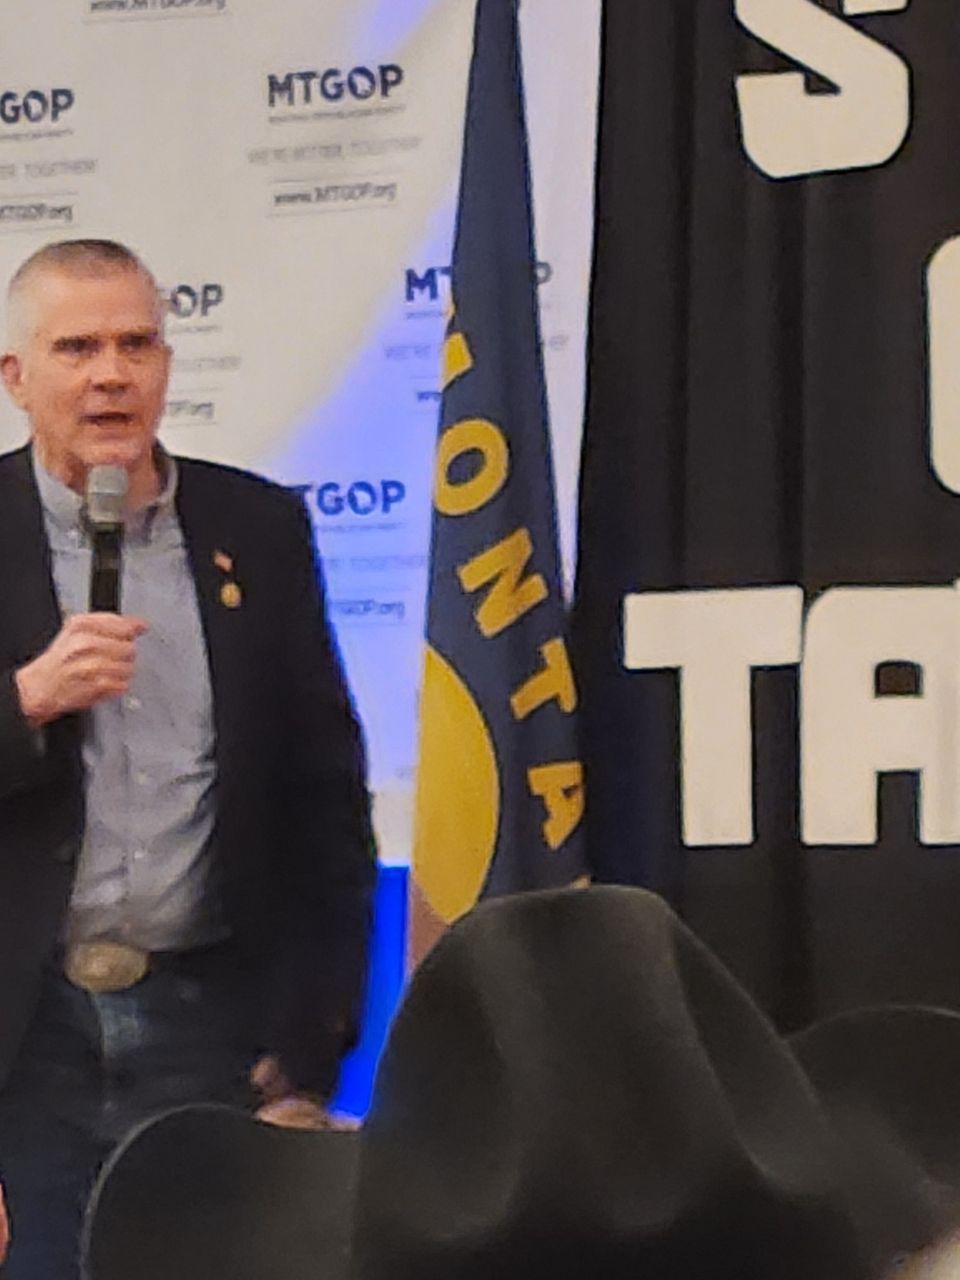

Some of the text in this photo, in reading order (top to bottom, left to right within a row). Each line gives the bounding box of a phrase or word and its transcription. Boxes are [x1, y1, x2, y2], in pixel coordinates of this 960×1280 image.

[266, 64, 404, 107] MTGOP
[274, 182, 397, 205] www.MTGOP.org
[433, 332, 592, 888] ONTA
